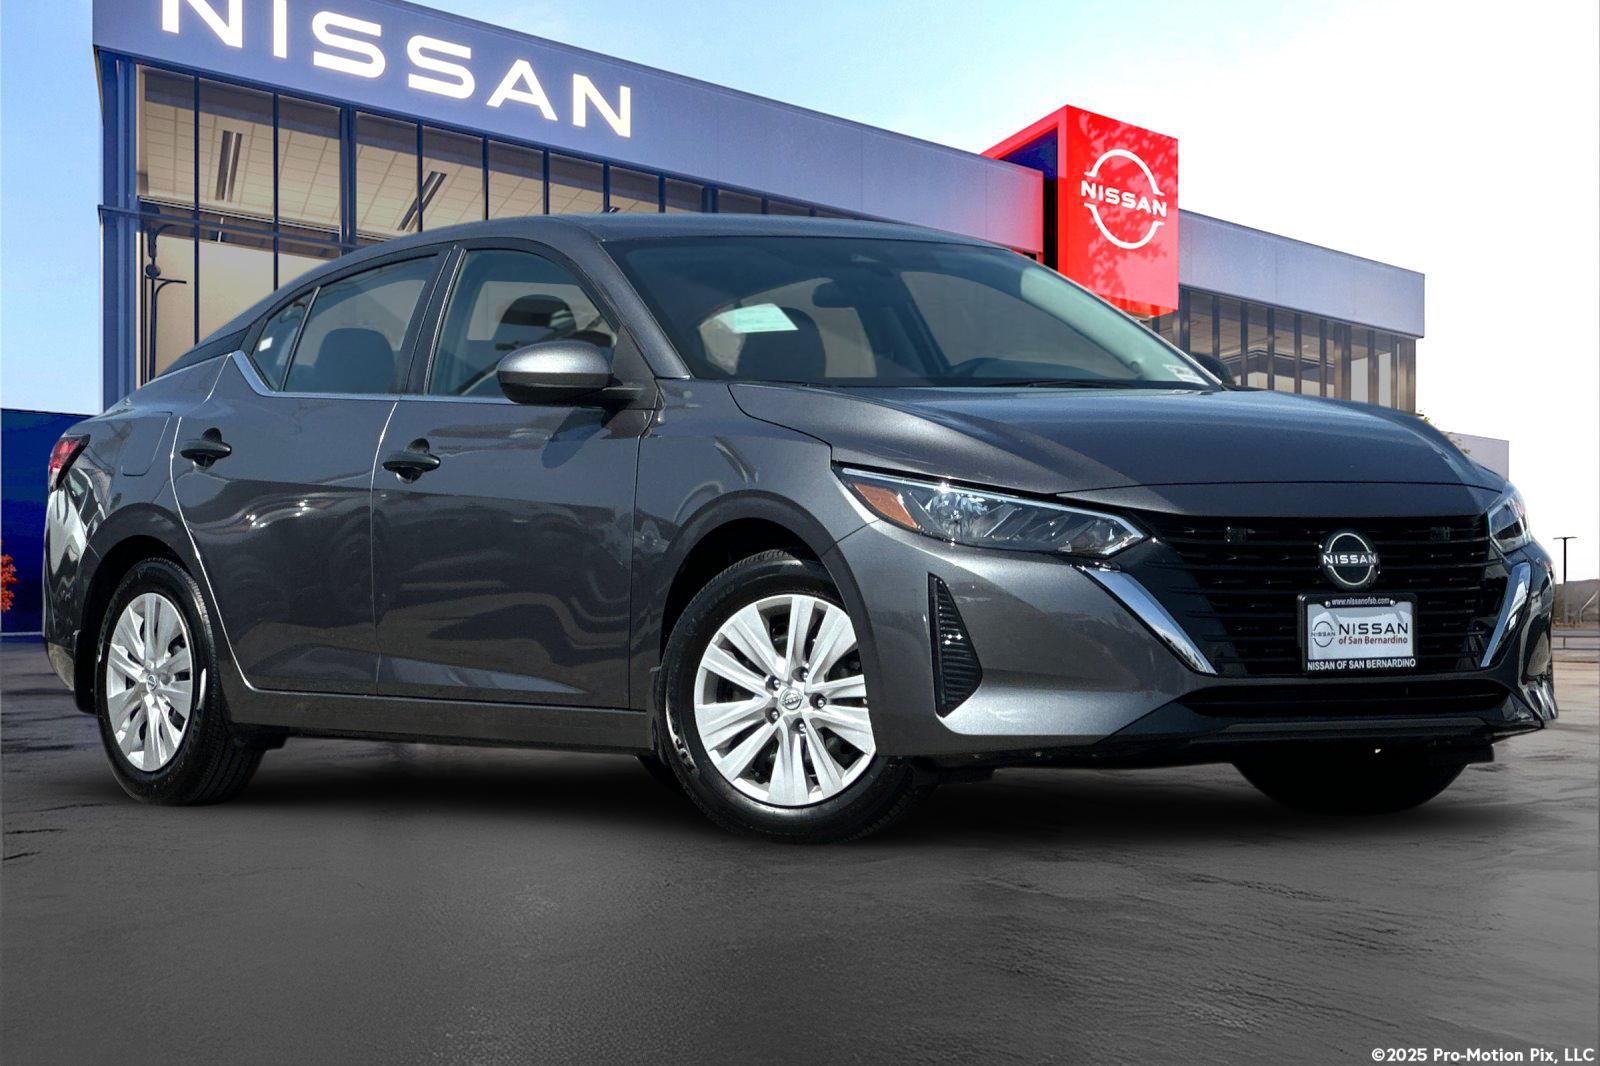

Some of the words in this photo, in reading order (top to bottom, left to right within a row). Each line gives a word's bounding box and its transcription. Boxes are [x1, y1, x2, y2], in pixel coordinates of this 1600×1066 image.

[161, 0, 632, 138] NISSAN
[1081, 180, 1167, 217] NISSAN
[1323, 554, 1377, 565] NISSAN
[1339, 623, 1408, 635] NISSAN
[1338, 636, 1347, 645] of
[1348, 636, 1362, 645] San
[1364, 636, 1408, 645] Bernardino
[1307, 661, 1335, 671] NISSAN
[1336, 661, 1347, 670] OF
[1348, 660, 1365, 669] SAN
[1366, 658, 1416, 669] BERNARDINO
